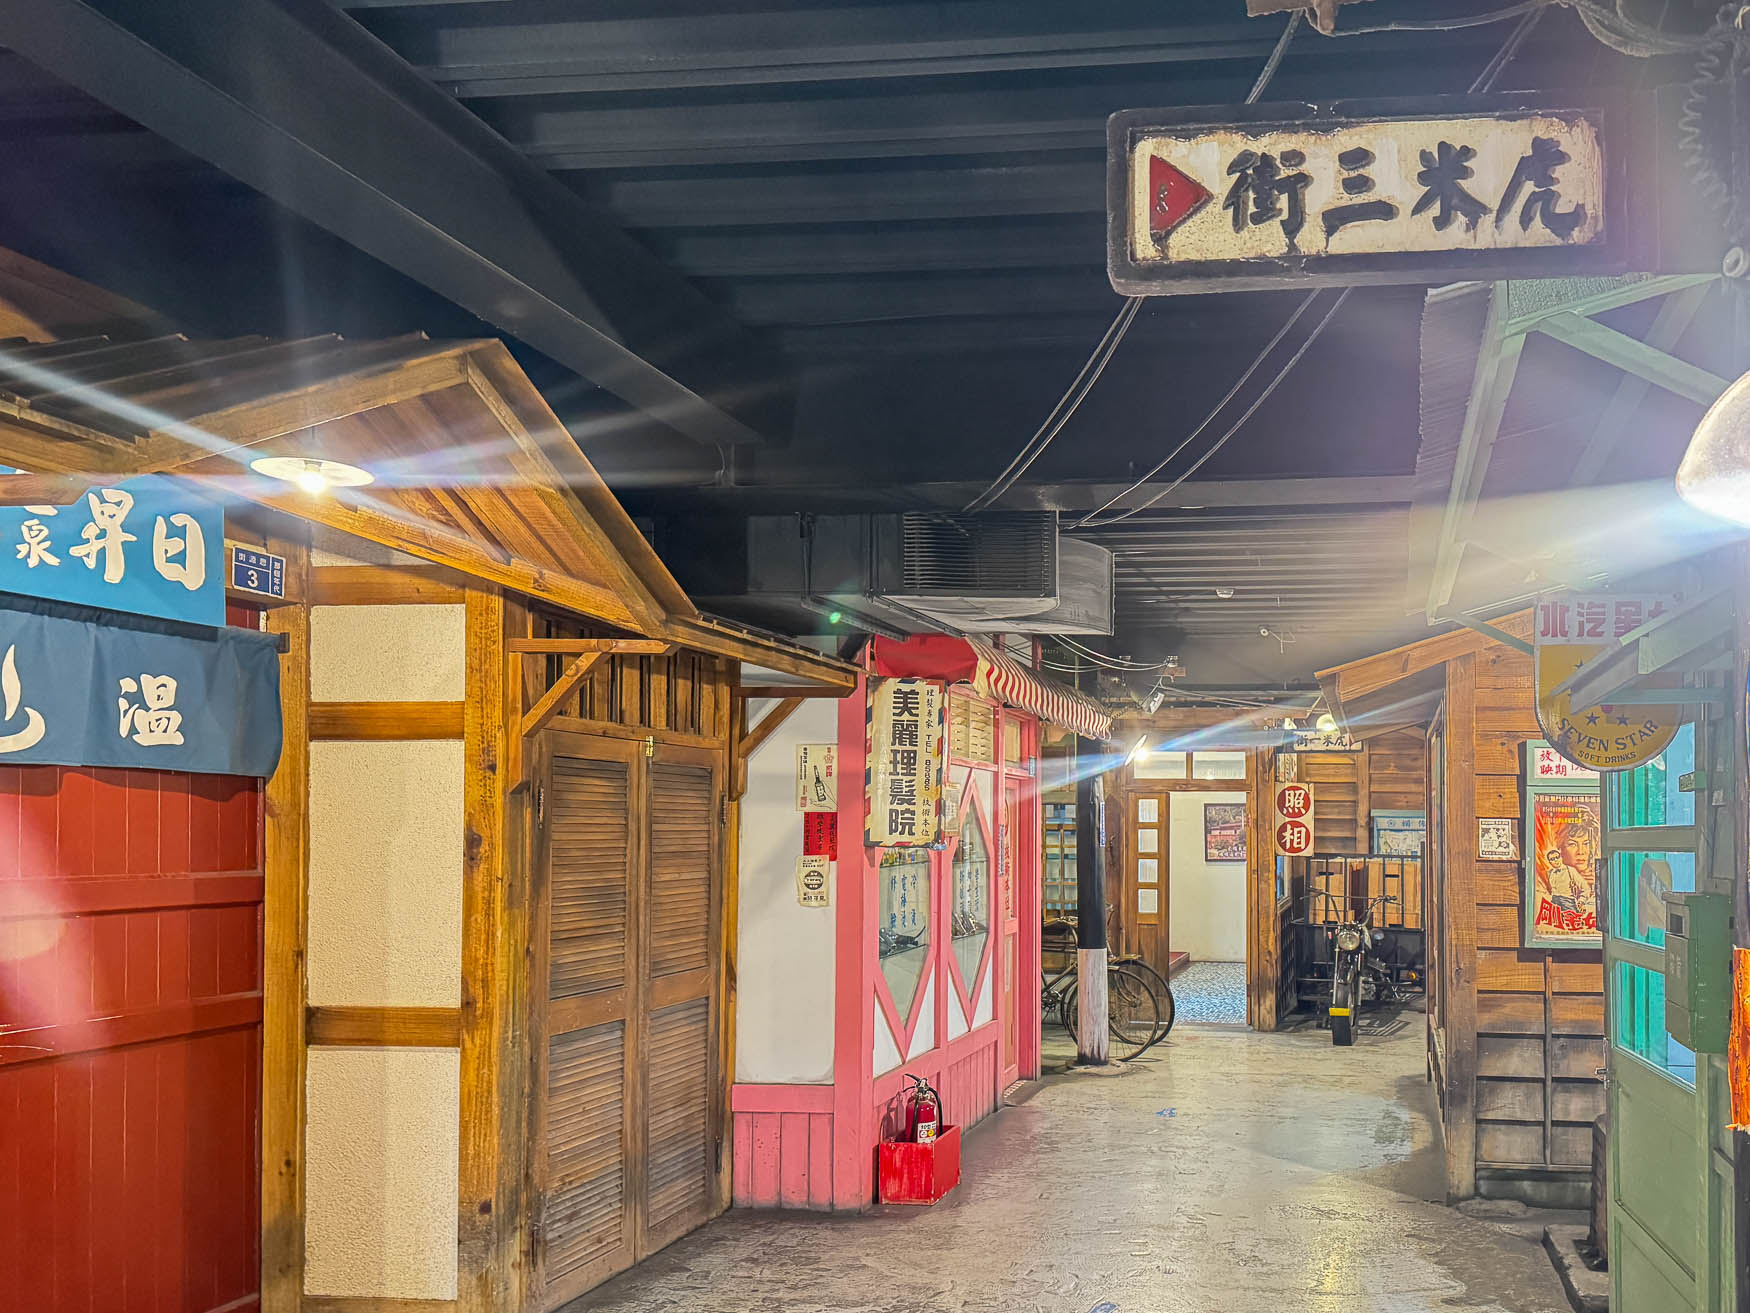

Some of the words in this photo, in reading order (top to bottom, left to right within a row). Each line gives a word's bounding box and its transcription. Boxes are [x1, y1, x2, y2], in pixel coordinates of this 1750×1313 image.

[247, 569, 259, 588] 3
[1558, 717, 1609, 752] SEVEN
[1615, 719, 1659, 751] STAR
[888, 688, 919, 837] 美麗理髮院
[1578, 750, 1601, 764] SOFT
[1604, 751, 1637, 764] DRINKS
[1282, 789, 1307, 850] 照相
